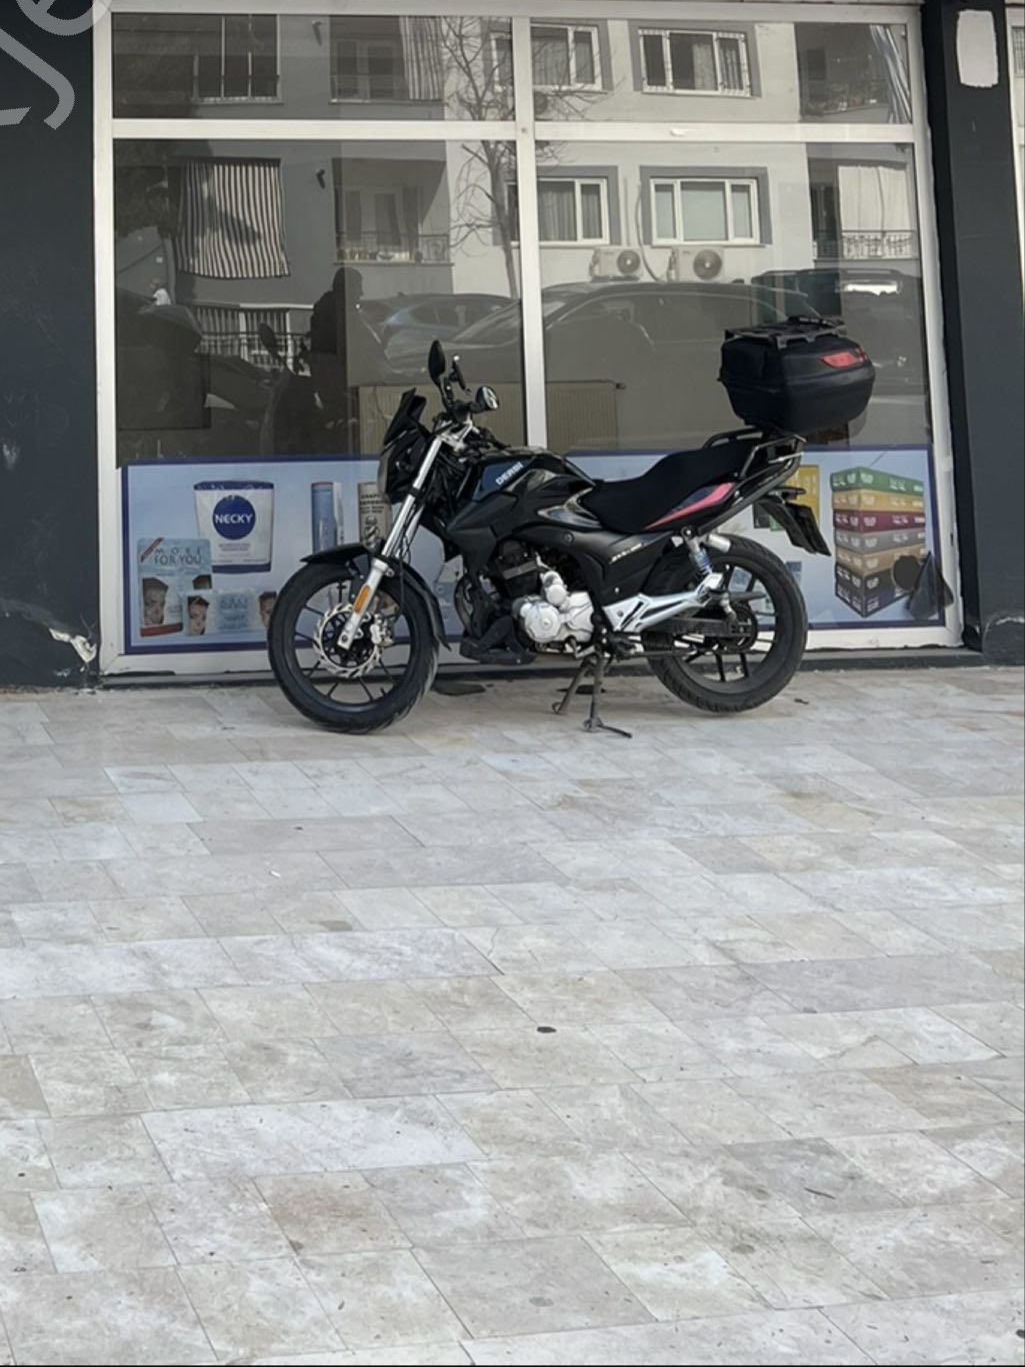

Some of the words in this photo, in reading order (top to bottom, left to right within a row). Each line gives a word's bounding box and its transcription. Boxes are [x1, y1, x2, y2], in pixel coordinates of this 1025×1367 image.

[495, 461, 524, 485] DERBI
[215, 514, 253, 524] NECKY
[179, 553, 202, 564] YOU
